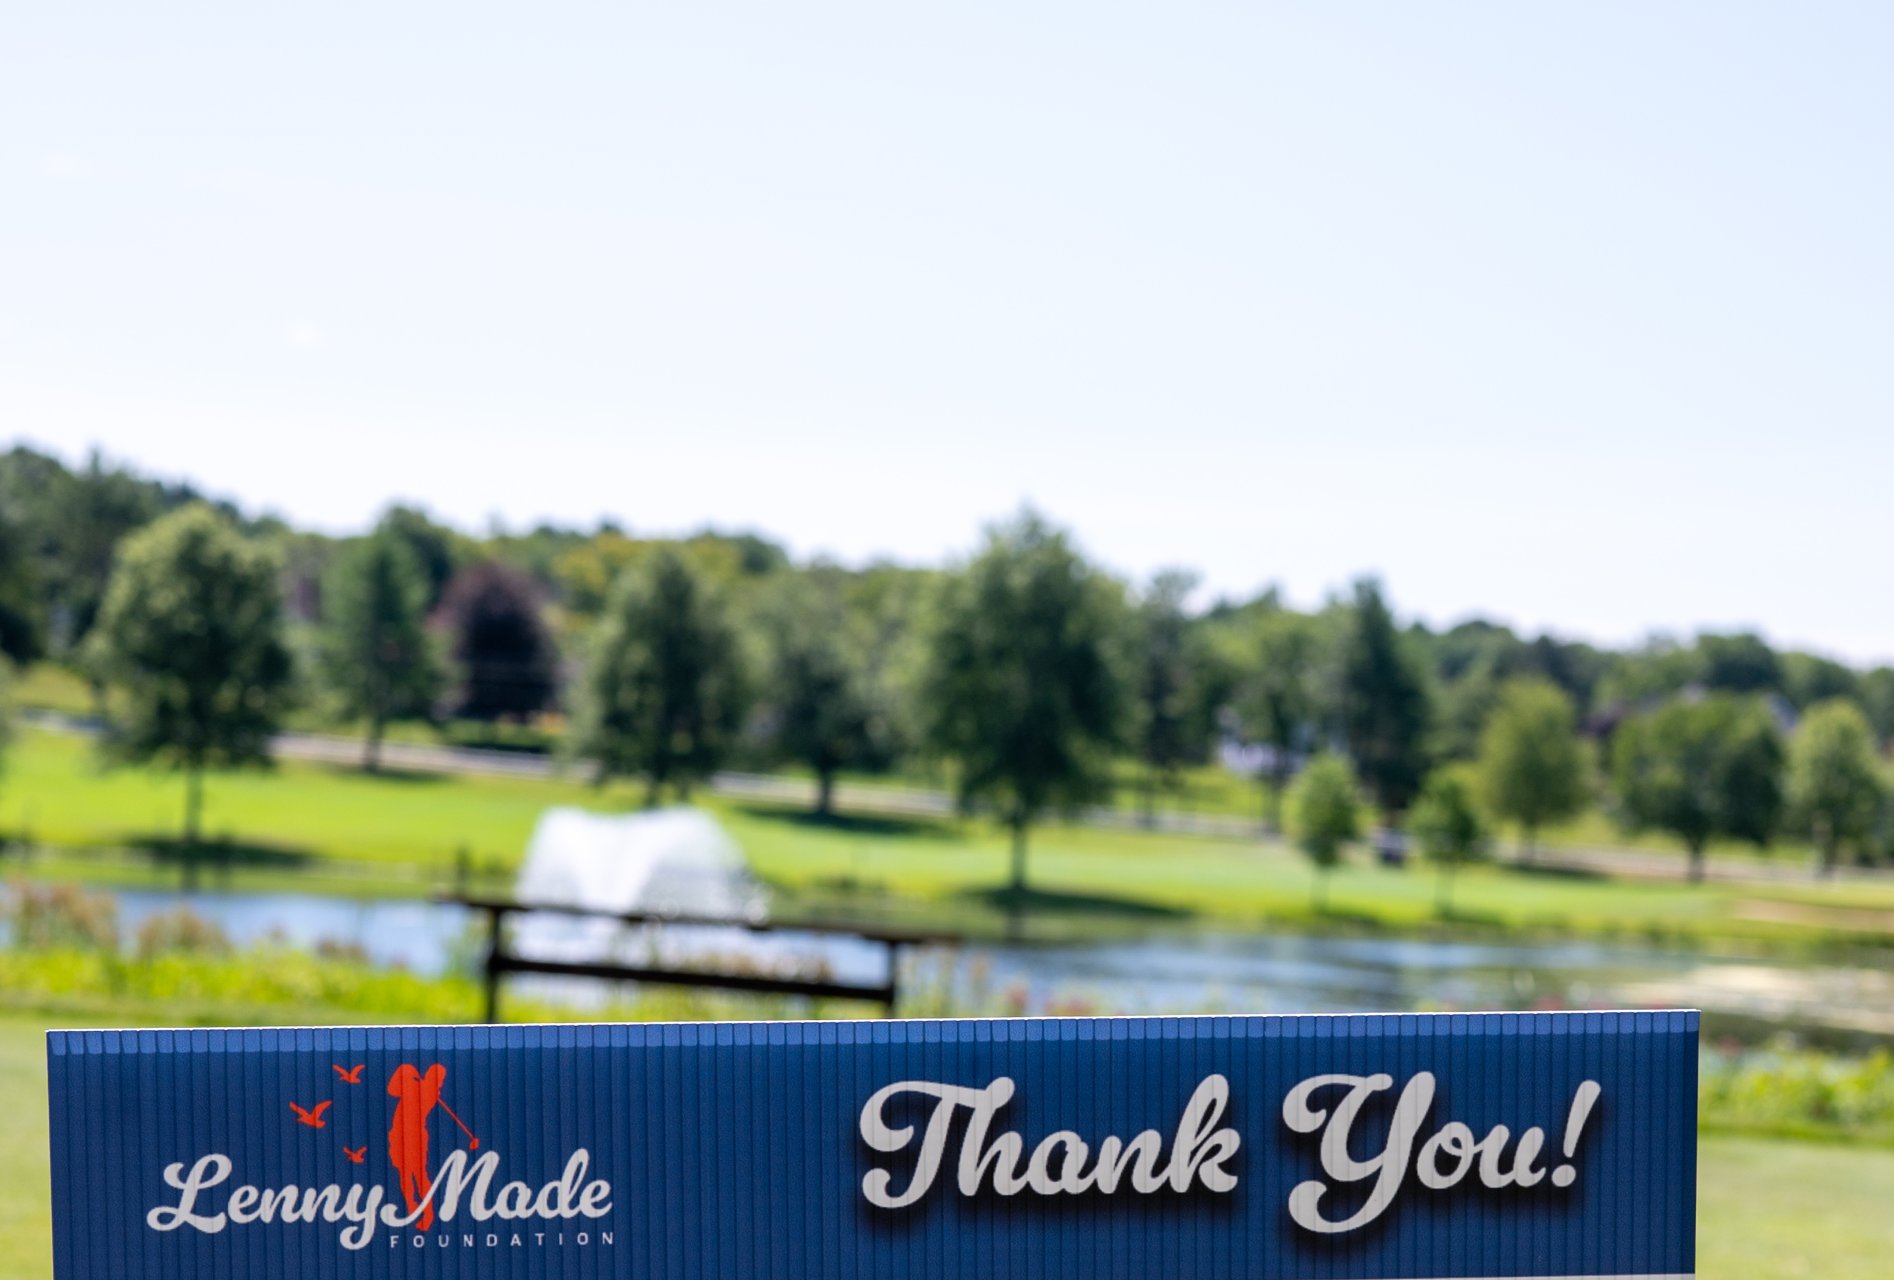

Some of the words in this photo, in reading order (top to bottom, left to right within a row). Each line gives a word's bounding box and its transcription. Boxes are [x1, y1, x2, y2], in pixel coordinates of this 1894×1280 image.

[147, 1153, 385, 1250] Lenny
[381, 1148, 613, 1227] Made
[859, 1073, 1241, 1208] Thank
[1281, 1071, 1602, 1234] You!
[390, 1231, 615, 1249] FOUNDATION
